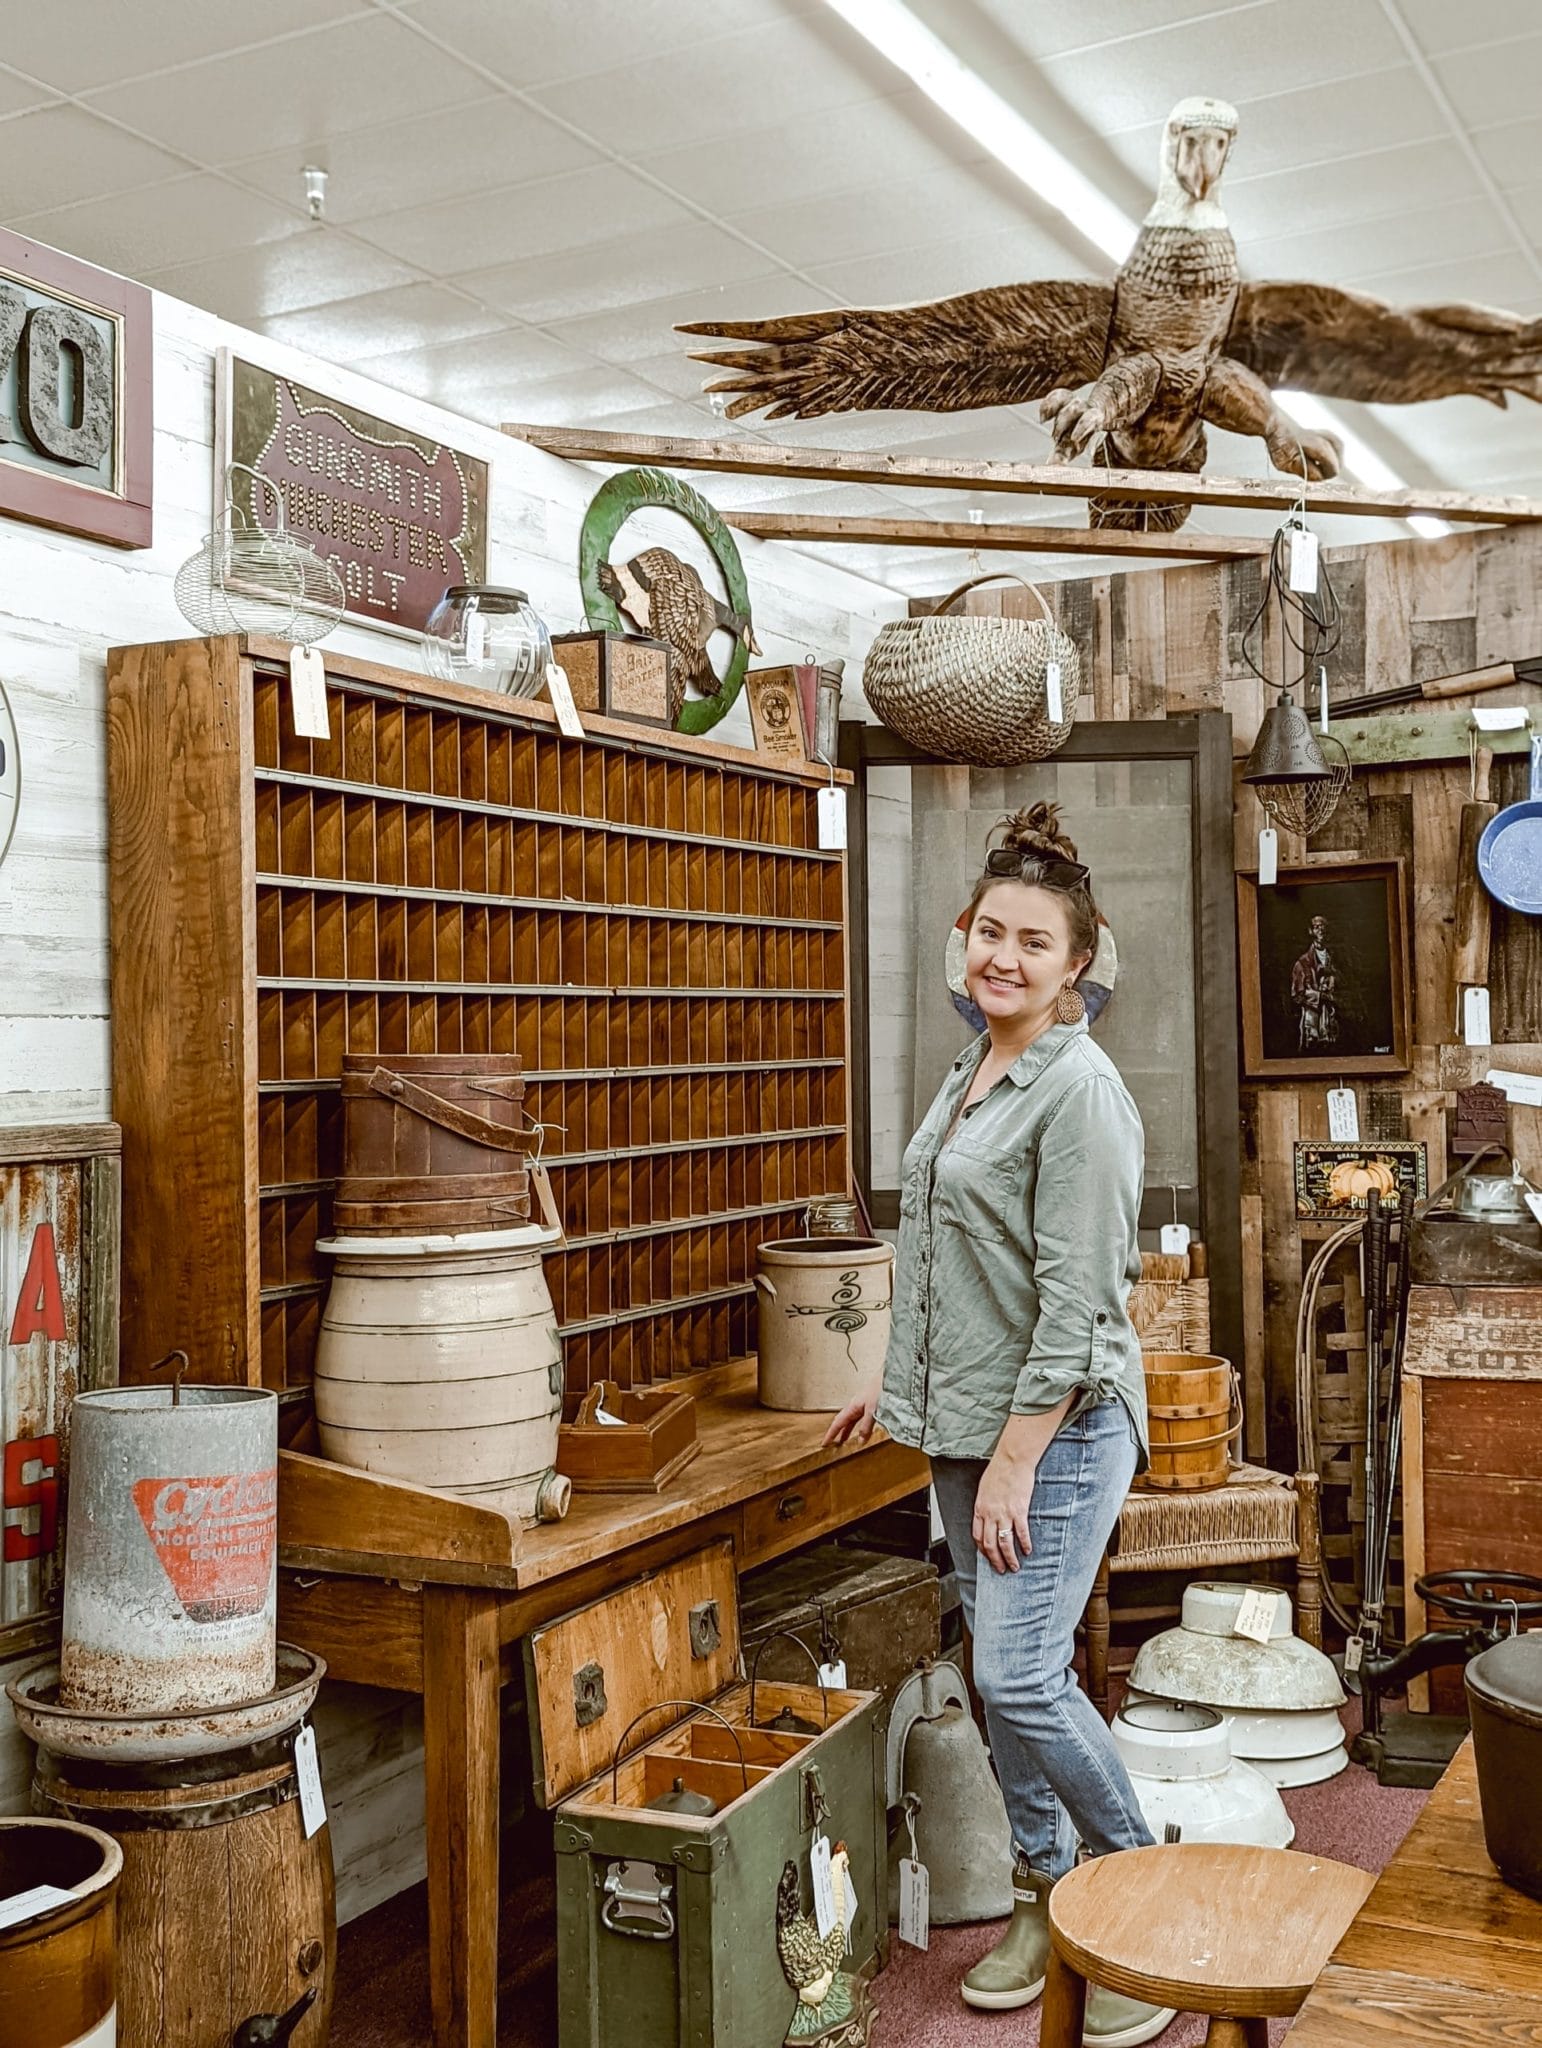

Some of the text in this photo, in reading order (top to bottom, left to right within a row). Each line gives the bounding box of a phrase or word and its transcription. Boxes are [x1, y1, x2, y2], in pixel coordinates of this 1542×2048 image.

[284, 424, 442, 519] GUNSMITH
[263, 474, 449, 575] WINCHESTER
[325, 552, 406, 612] COLT
[1350, 1194, 1399, 1210] PUKIN
[8, 1222, 67, 1346] A
[3, 1433, 60, 1563] S
